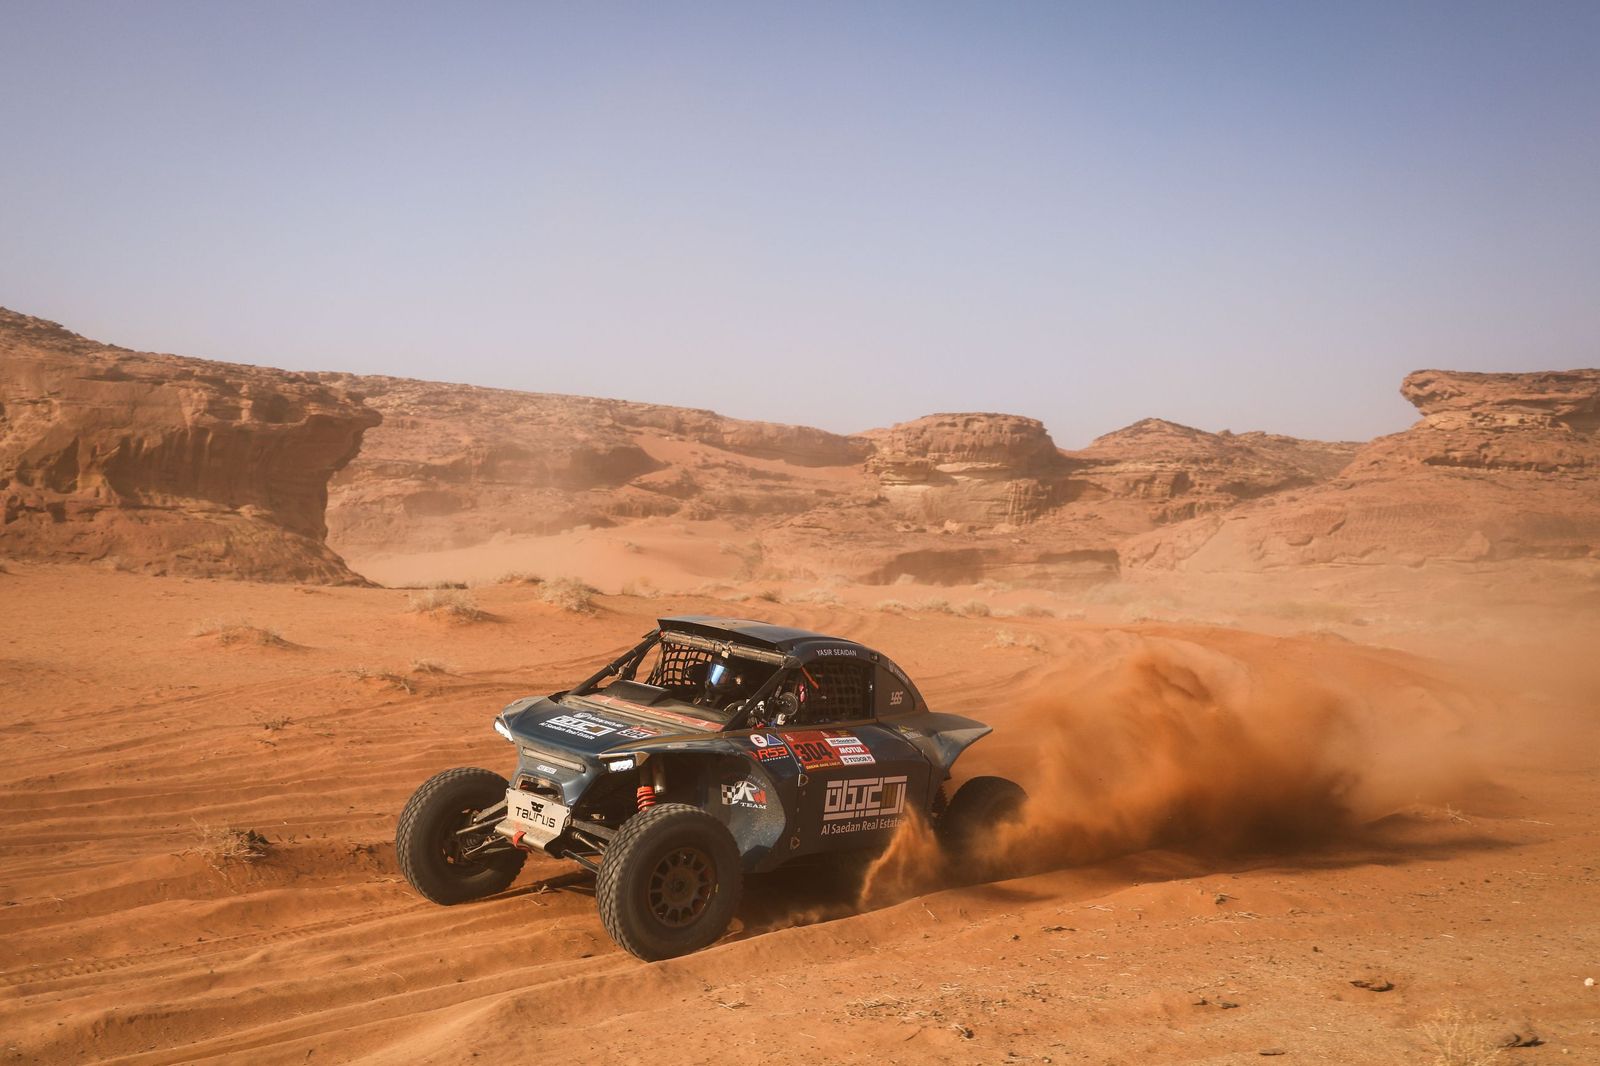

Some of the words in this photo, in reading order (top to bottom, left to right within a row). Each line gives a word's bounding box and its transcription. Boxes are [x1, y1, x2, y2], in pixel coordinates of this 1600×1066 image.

[816, 648, 832, 656] YASIR
[833, 648, 857, 656] SEAIDAN
[547, 722, 566, 733] Saedan
[565, 729, 579, 737] Real
[577, 731, 595, 740] Estate
[793, 742, 833, 762] 304
[838, 746, 865, 754] MOTUL
[821, 824, 830, 835] Al
[831, 822, 860, 834] Saedan
[861, 820, 879, 831] Real
